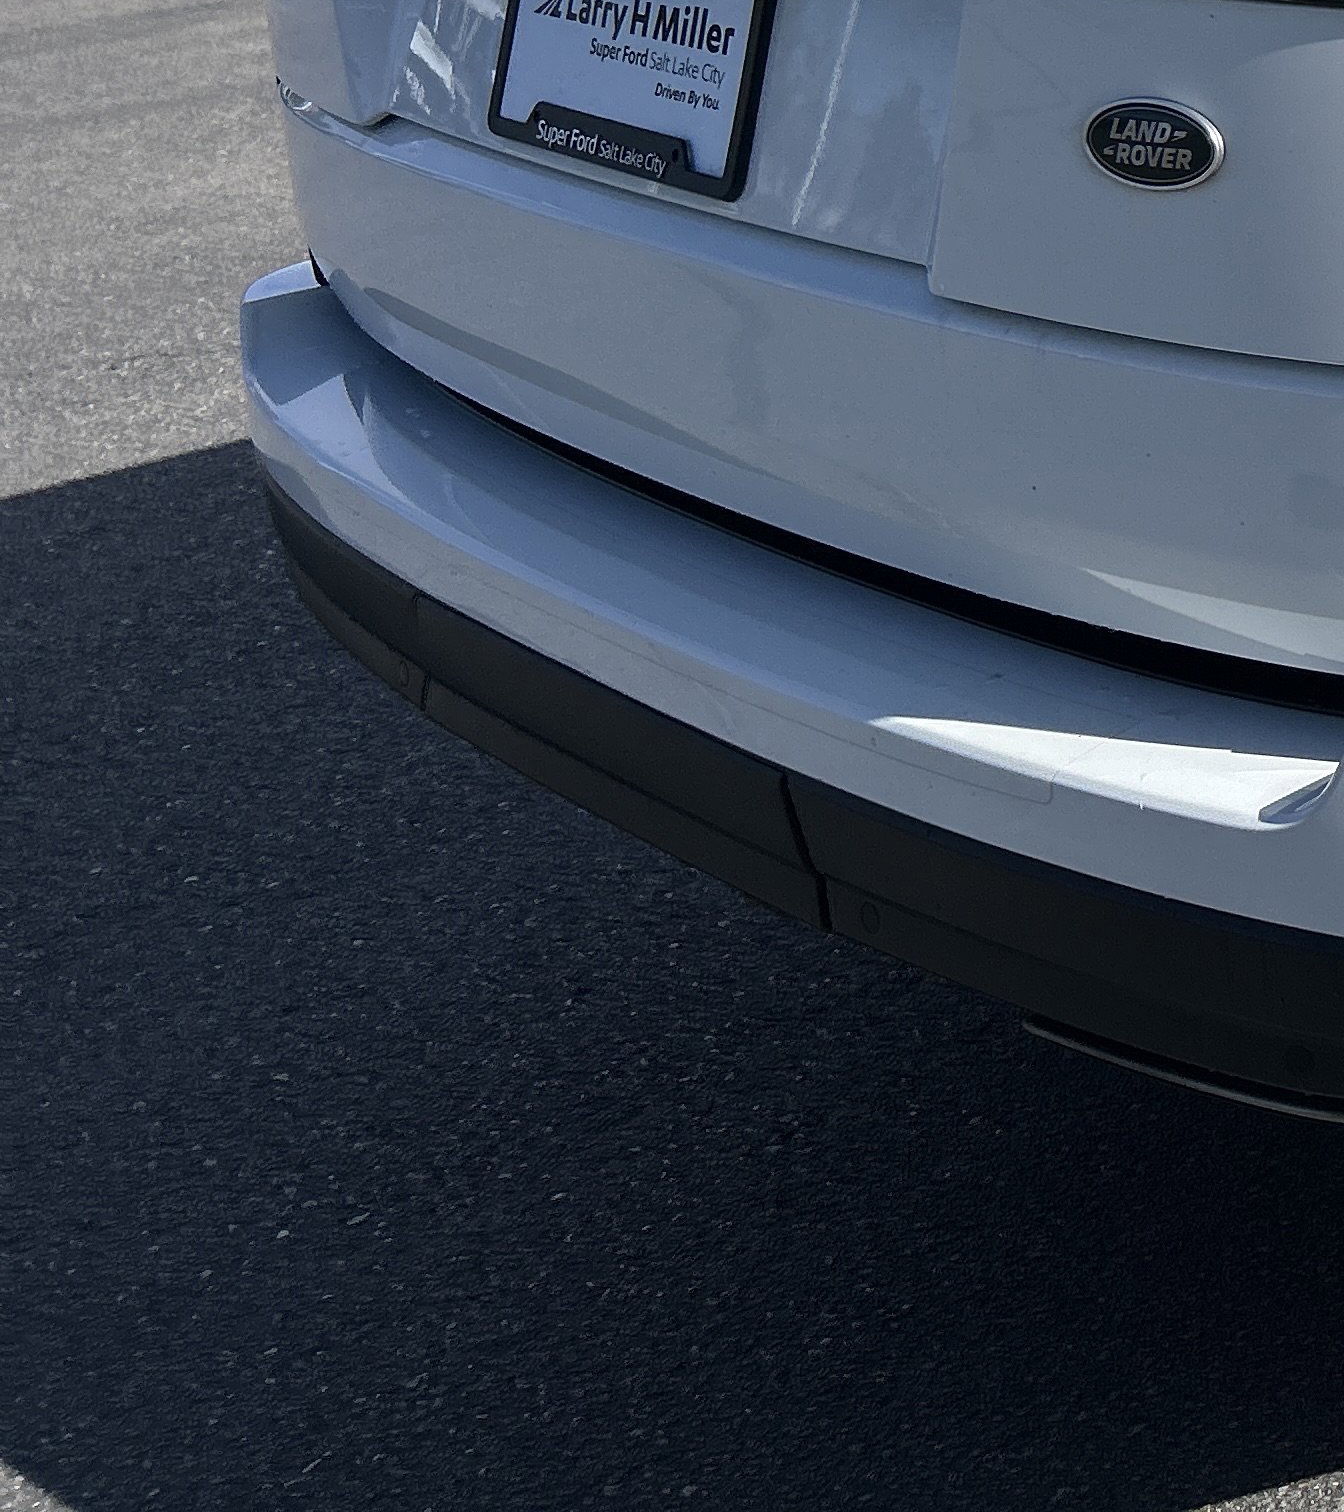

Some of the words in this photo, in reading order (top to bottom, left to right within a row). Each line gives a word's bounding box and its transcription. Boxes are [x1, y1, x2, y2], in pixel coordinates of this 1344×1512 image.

[652, 4, 735, 56] Miller
[590, 37, 622, 62] Super
[622, 45, 649, 68] Ford
[649, 51, 671, 74] Salt
[672, 57, 699, 80] Lake
[701, 63, 726, 89] City
[654, 82, 686, 103] Driven
[687, 90, 701, 109] By
[535, 119, 570, 148] Super
[569, 128, 598, 155] Ford
[598, 140, 619, 162] Salt
[619, 146, 643, 169] Lake
[644, 152, 667, 179] City
[1109, 117, 1172, 144] LAND
[1115, 142, 1193, 170] ROVER
